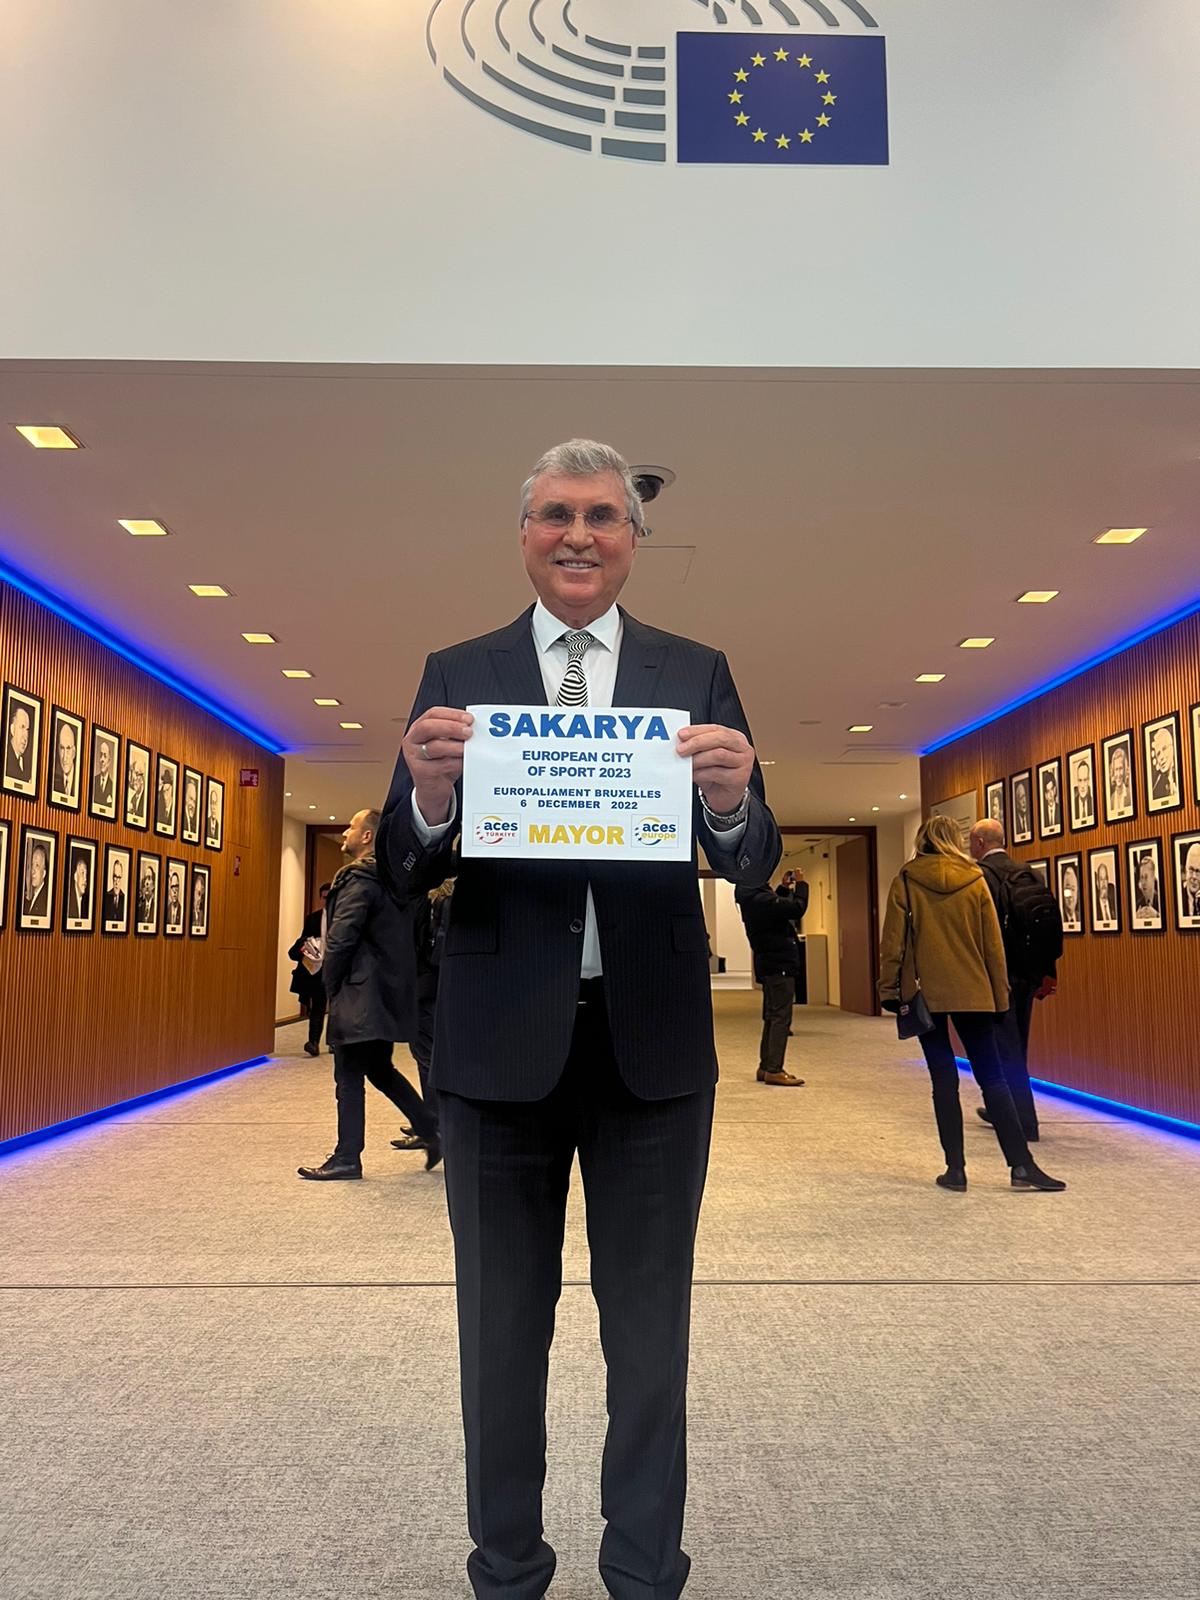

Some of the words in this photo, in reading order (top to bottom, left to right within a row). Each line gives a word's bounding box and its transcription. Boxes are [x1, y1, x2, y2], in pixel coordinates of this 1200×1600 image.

[489, 712, 670, 741] SAKARYA
[522, 750, 598, 763] EUROPEAN
[601, 752, 634, 763] CITY
[527, 766, 546, 777] OF
[550, 766, 596, 778] SPORT
[599, 767, 631, 779] 2023
[493, 787, 591, 798] EUROPALIAMENT
[594, 789, 662, 799] BRUXELLES
[520, 799, 527, 808] 6
[537, 799, 601, 809] DECEMBER
[611, 801, 638, 810] 2022
[484, 820, 518, 831] aces
[642, 822, 677, 833] aces
[528, 823, 625, 846] MAYOR
[641, 832, 677, 841] europe
